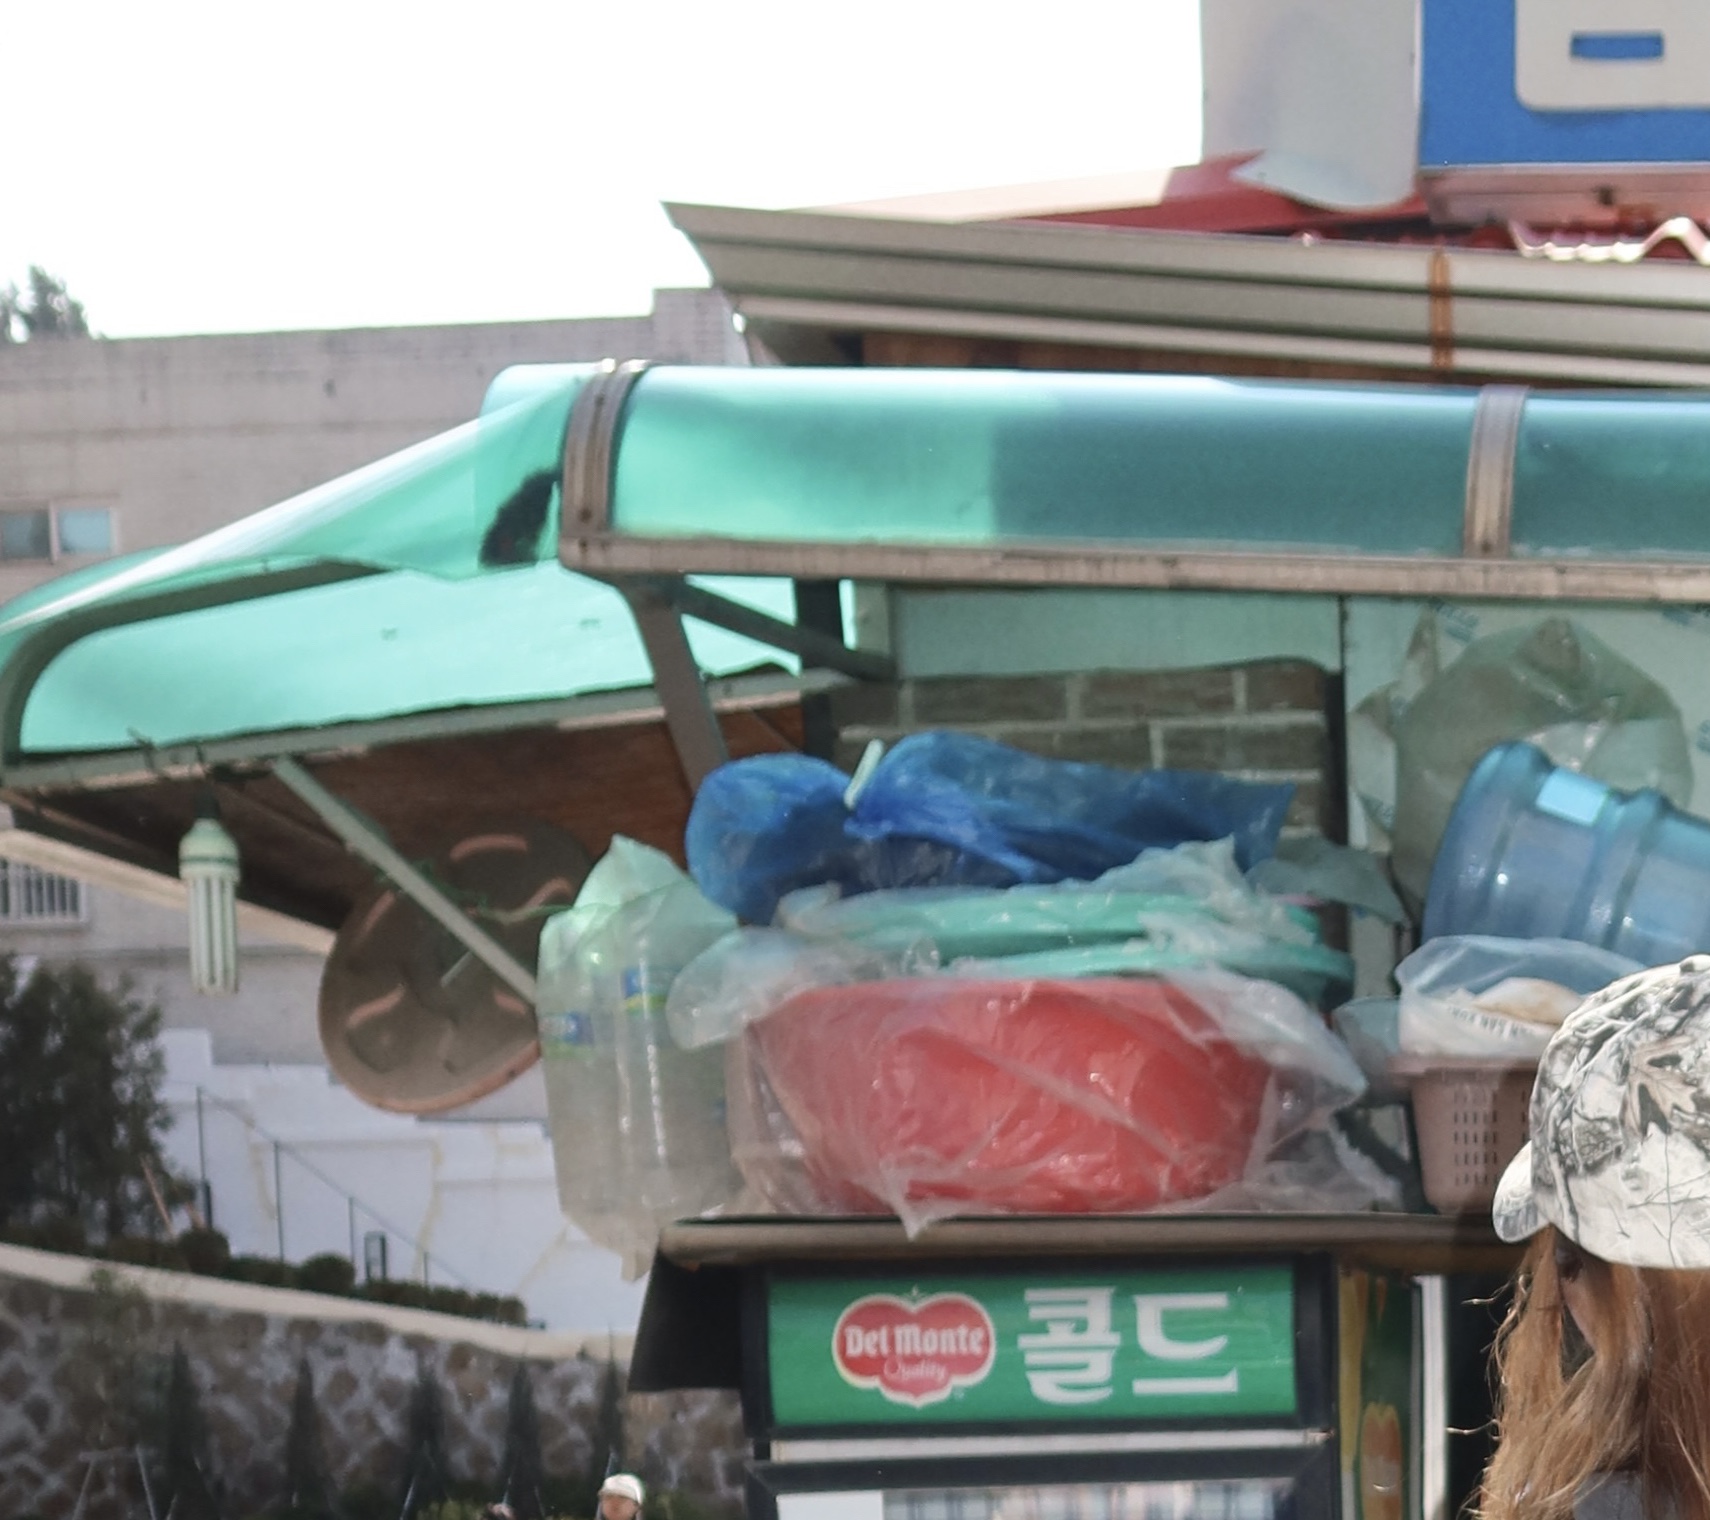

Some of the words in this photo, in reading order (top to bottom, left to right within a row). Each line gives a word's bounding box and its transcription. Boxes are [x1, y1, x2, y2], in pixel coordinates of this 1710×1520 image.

[844, 1324, 889, 1358] Del
[894, 1323, 985, 1357] Monte
[1017, 1286, 1238, 1404] 콜드
